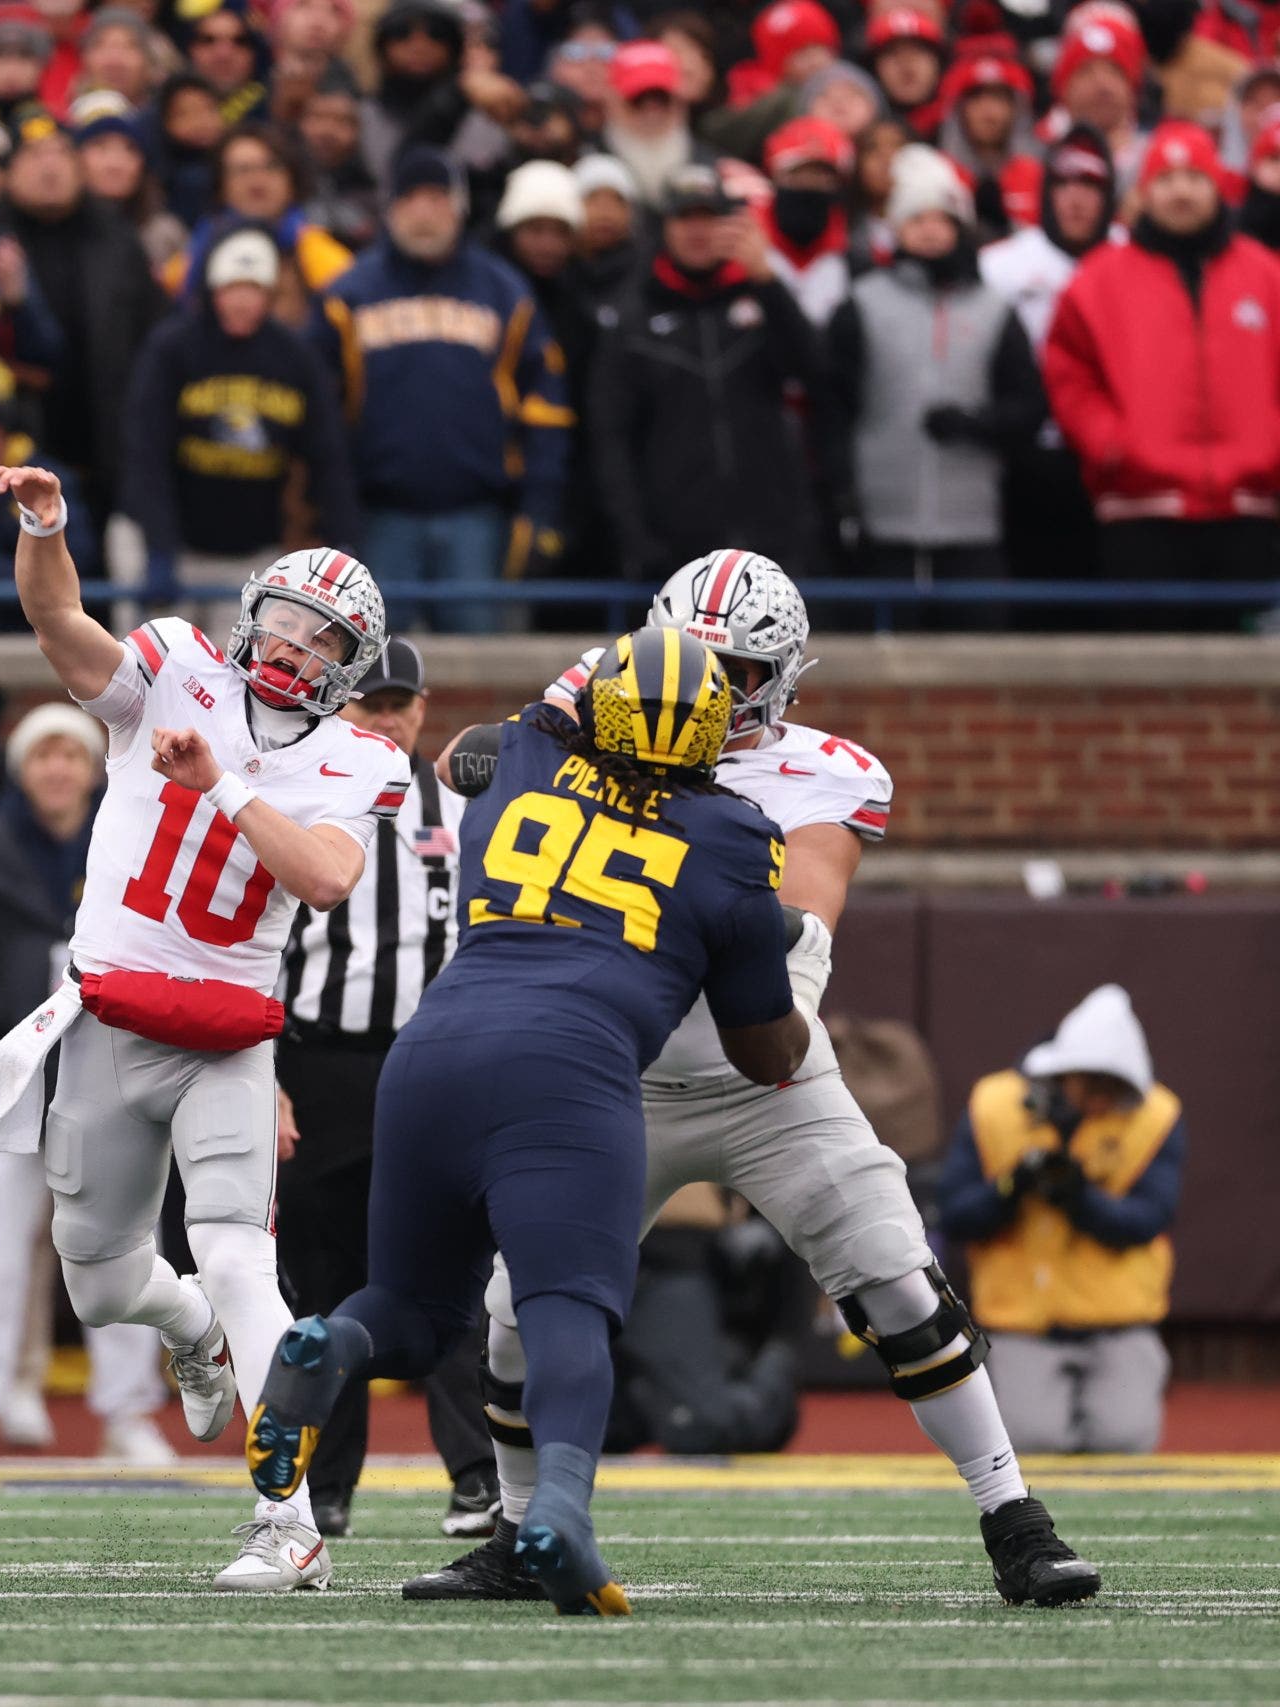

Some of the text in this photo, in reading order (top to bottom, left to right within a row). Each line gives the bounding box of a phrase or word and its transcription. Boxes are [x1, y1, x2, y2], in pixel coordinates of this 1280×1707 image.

[301, 583, 338, 607] OHIO STATE
[122, 780, 276, 948] 10
[428, 886, 450, 921] C
[469, 791, 690, 954] 95
